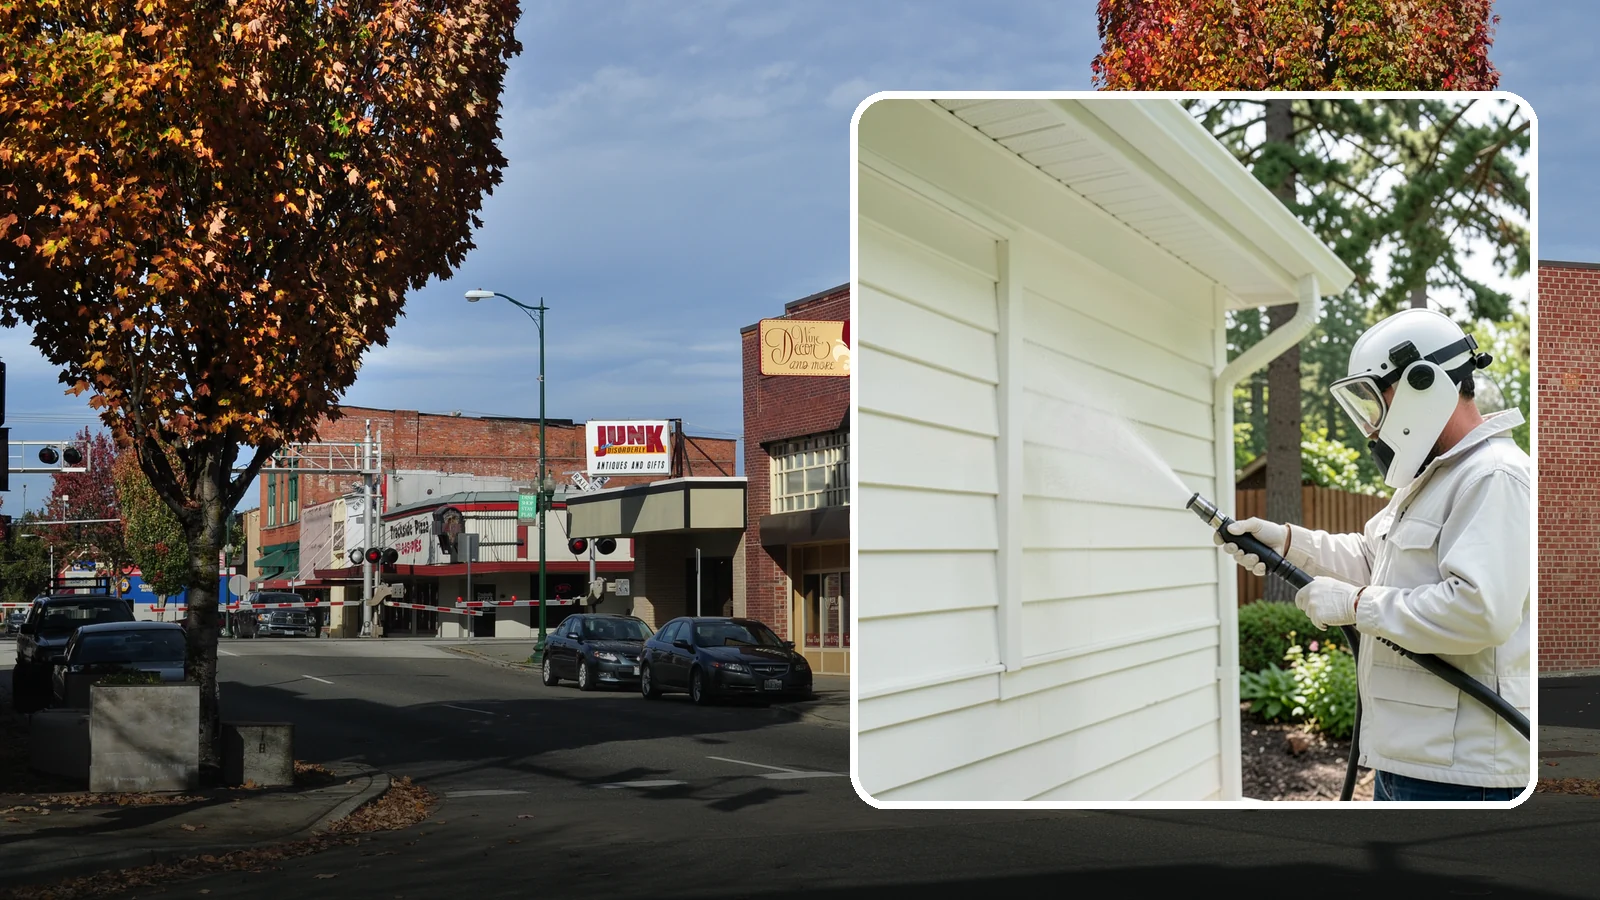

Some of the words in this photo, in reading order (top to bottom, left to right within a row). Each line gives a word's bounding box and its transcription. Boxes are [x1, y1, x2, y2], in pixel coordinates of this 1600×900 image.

[595, 425, 666, 457] JUNK
[607, 446, 646, 454] DISORDERLY
[597, 461, 628, 470] ANTIQUES
[631, 461, 644, 470] AND
[647, 461, 665, 470] GIFTS
[352, 498, 364, 510] CRO
[390, 521, 413, 540] Trackside
[414, 520, 429, 535] Pizza
